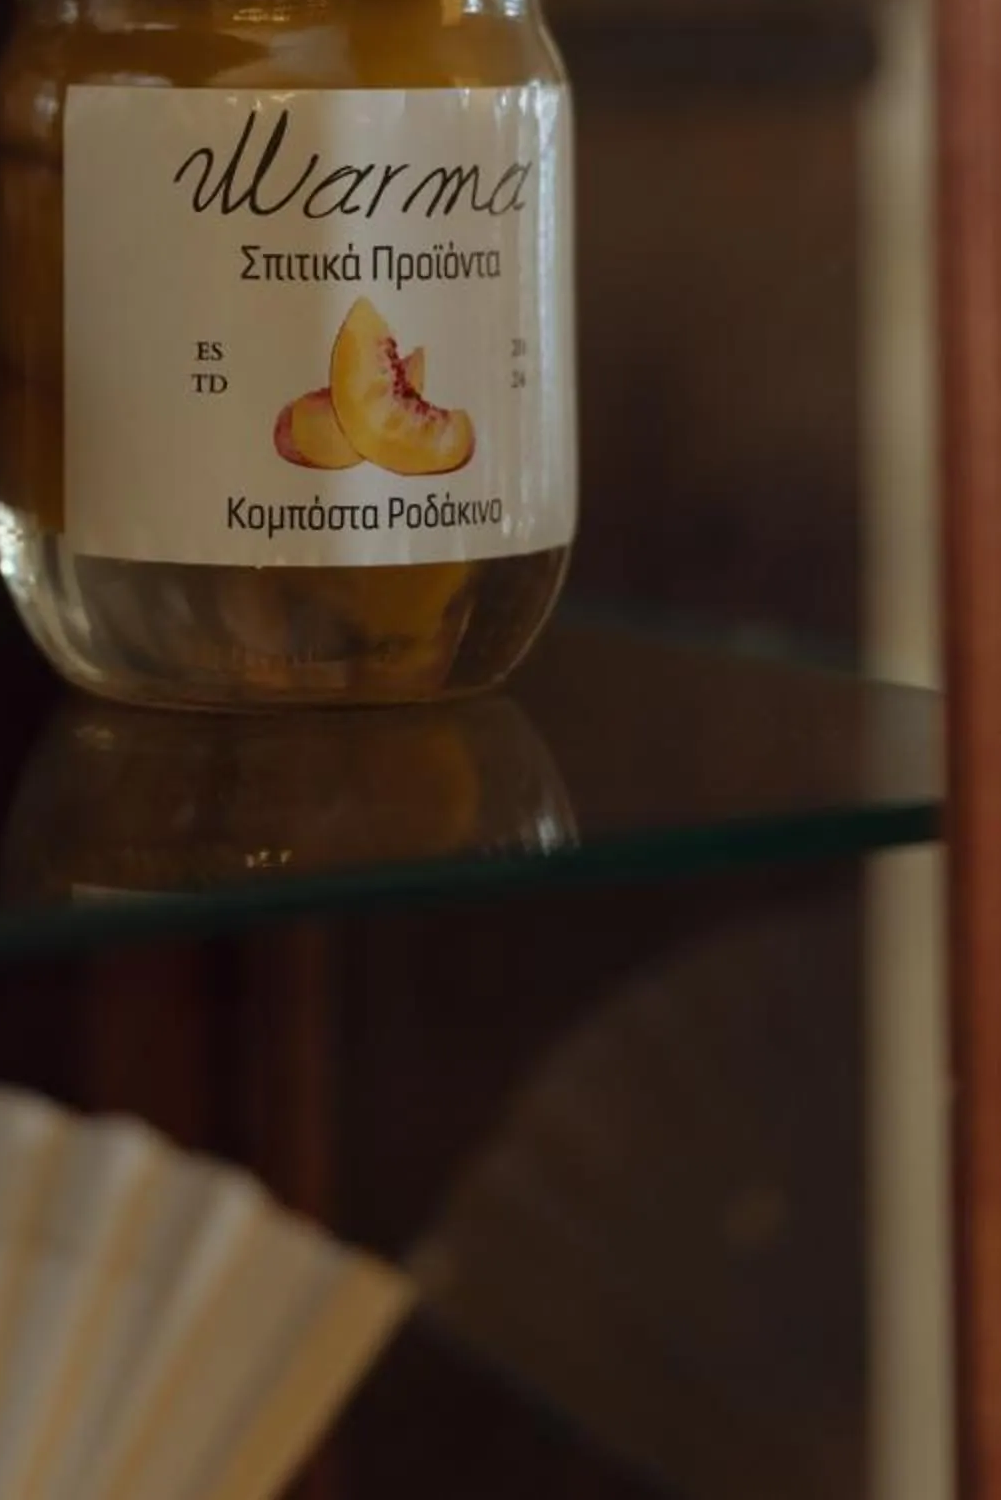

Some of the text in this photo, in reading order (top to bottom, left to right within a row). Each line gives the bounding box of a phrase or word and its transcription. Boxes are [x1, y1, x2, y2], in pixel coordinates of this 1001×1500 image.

[173, 109, 533, 219] Warma
[240, 243, 500, 290] Σπιτικά Προϊόντα
[196, 341, 223, 362] ES
[191, 373, 228, 395] TD
[227, 494, 502, 538] Κομπόστα Ροδάκινο
